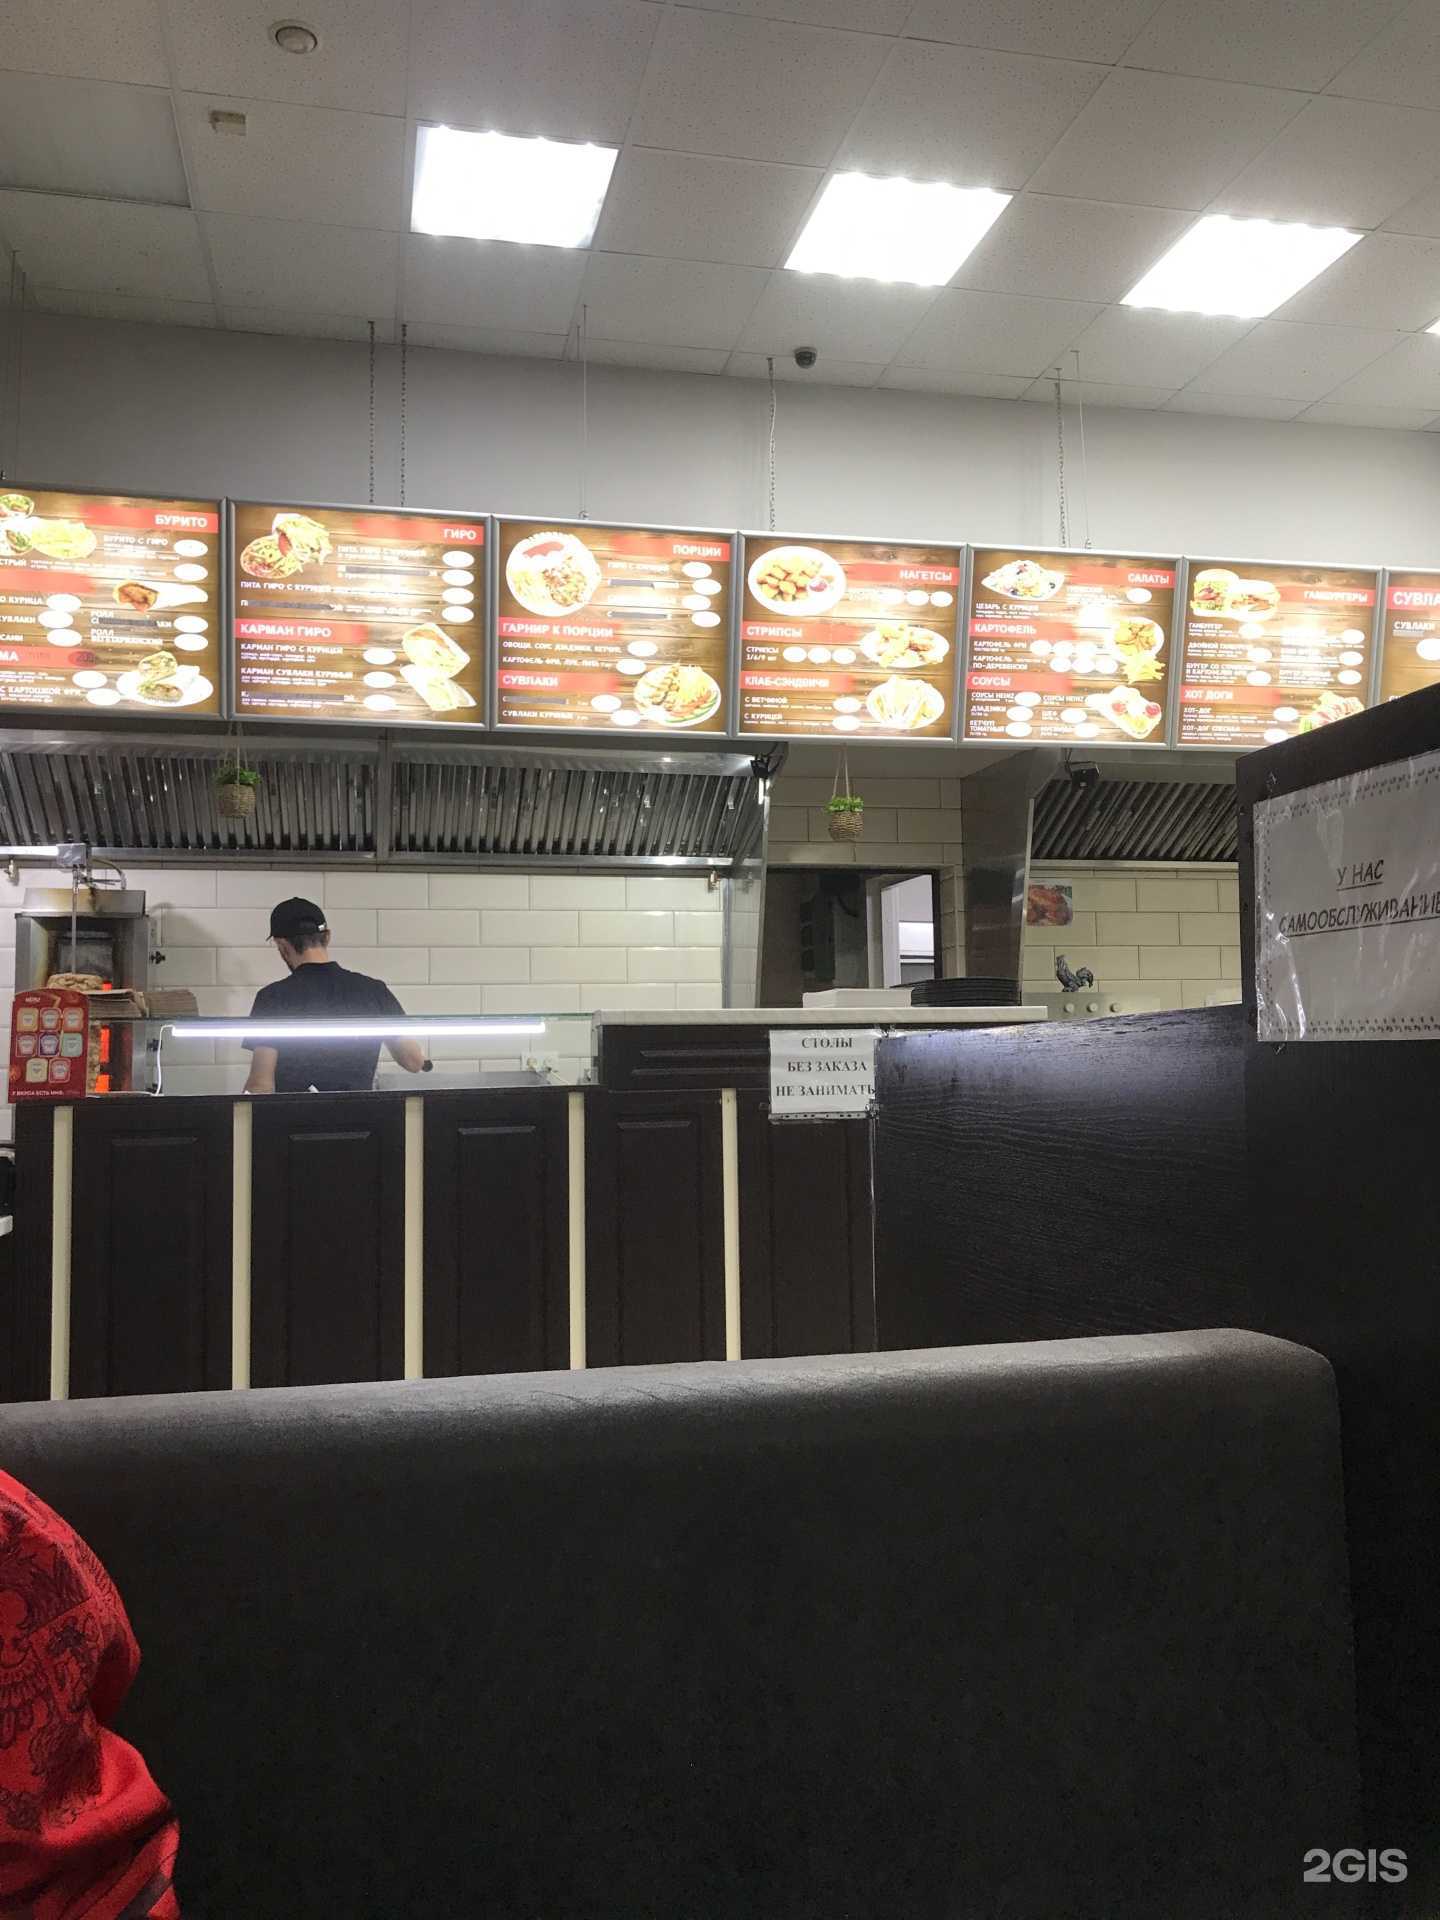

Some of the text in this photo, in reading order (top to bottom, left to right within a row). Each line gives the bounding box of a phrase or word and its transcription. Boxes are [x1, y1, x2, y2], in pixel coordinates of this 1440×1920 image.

[155, 514, 208, 528] БУРИТО
[443, 527, 478, 541] ГИРО
[138, 537, 145, 545] С
[672, 544, 722, 557] ПОРЦИИ
[899, 570, 953, 581] НАГЕТСЫ
[1127, 573, 1170, 584] САЛАТЫ
[240, 581, 261, 589] ПИТА
[240, 623, 332, 638] КАРМАН ГИРО
[502, 623, 614, 638] ГАРНИР К ПОРЦИИ
[746, 626, 802, 638] СТРИПСЫ
[974, 623, 1037, 635] КАРТОФЕЛЬ
[1393, 621, 1435, 631] СУВЛАКИ
[241, 643, 273, 651] КАРМАН
[275, 644, 297, 652] ГИРО
[502, 674, 559, 687] СУВЛАКИ
[971, 676, 1011, 686] СОУСЫ
[1184, 689, 1203, 700] ХОТ
[1337, 860, 1384, 886] У НАС
[801, 1037, 853, 1049] СТОЛЫ
[787, 1060, 868, 1072] БЕЗ ЗАКАЗА
[776, 1083, 876, 1097] НЕ ЗАНИМАТЬ
